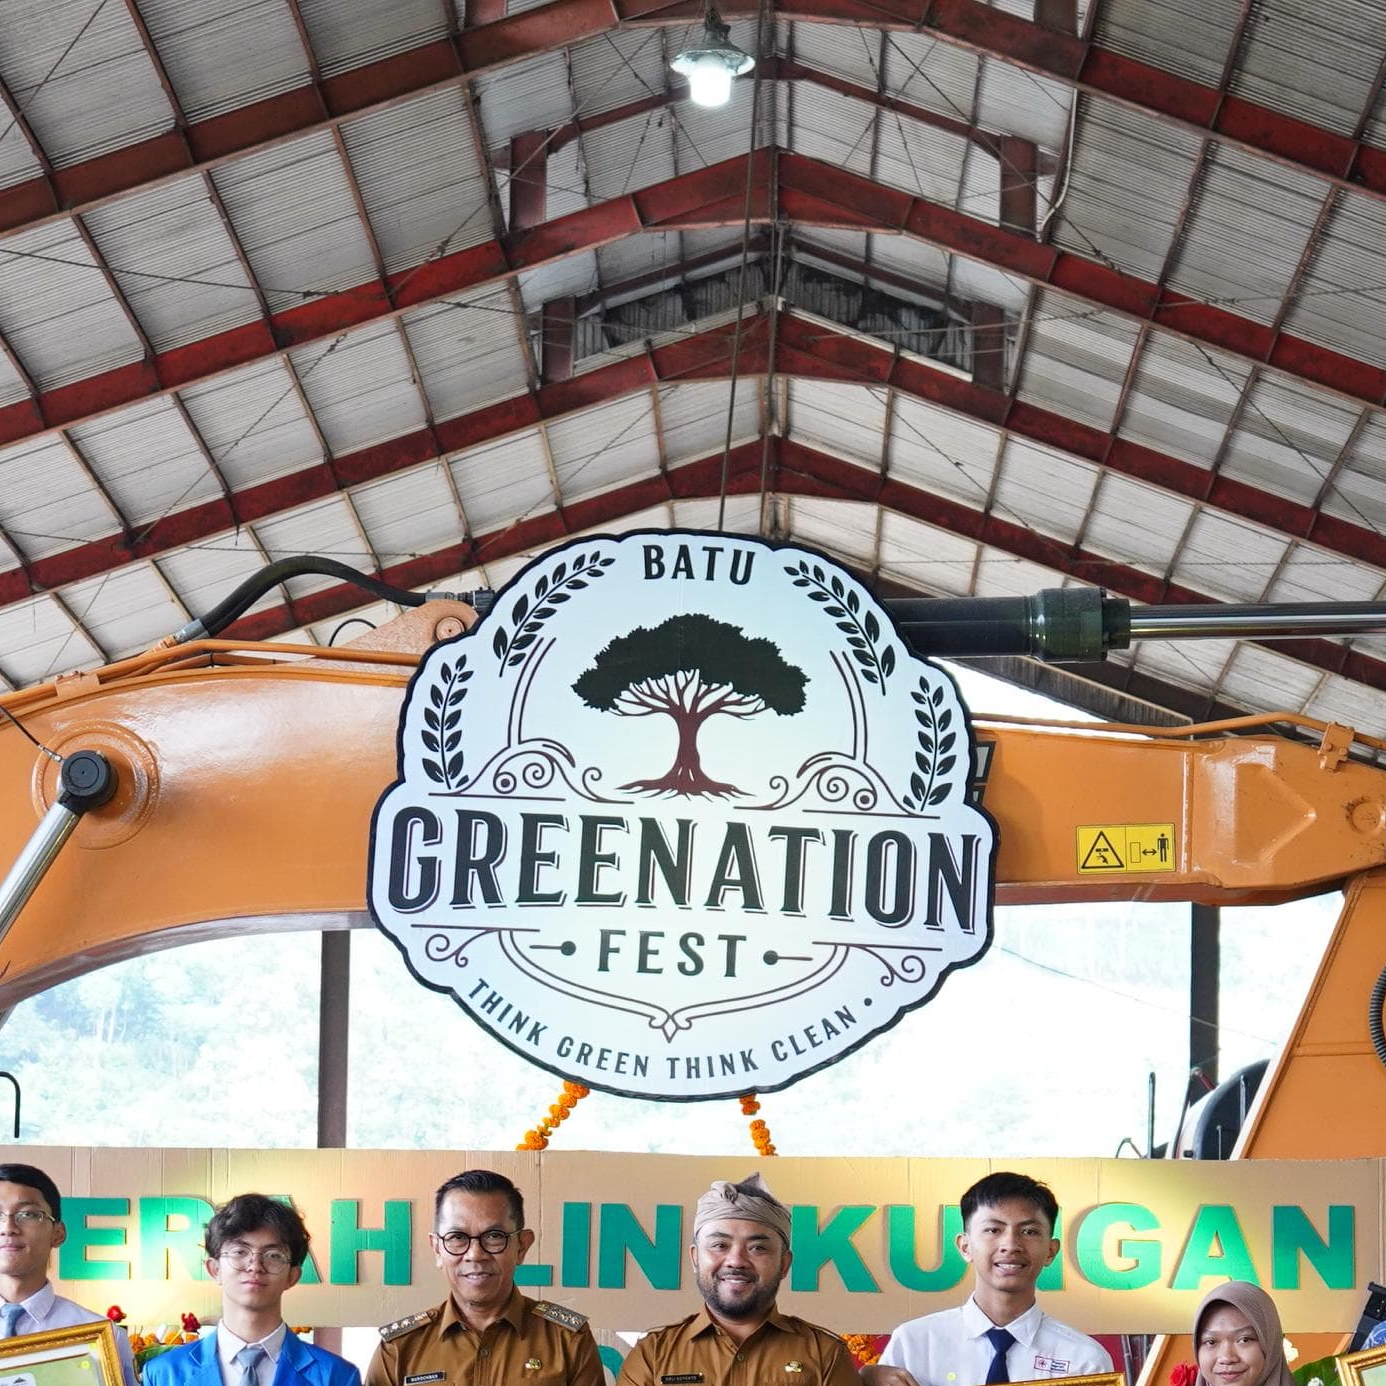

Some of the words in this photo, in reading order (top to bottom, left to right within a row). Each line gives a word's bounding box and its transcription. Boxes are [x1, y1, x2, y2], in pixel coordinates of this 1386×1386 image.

[642, 544, 756, 585] BATU
[387, 806, 981, 935] GREENATION
[597, 929, 748, 979] FEST
[467, 977, 547, 1046] THINK
[555, 1036, 650, 1080] GREEN
[666, 1048, 761, 1080] THINK
[769, 1004, 858, 1064] CLEAN
